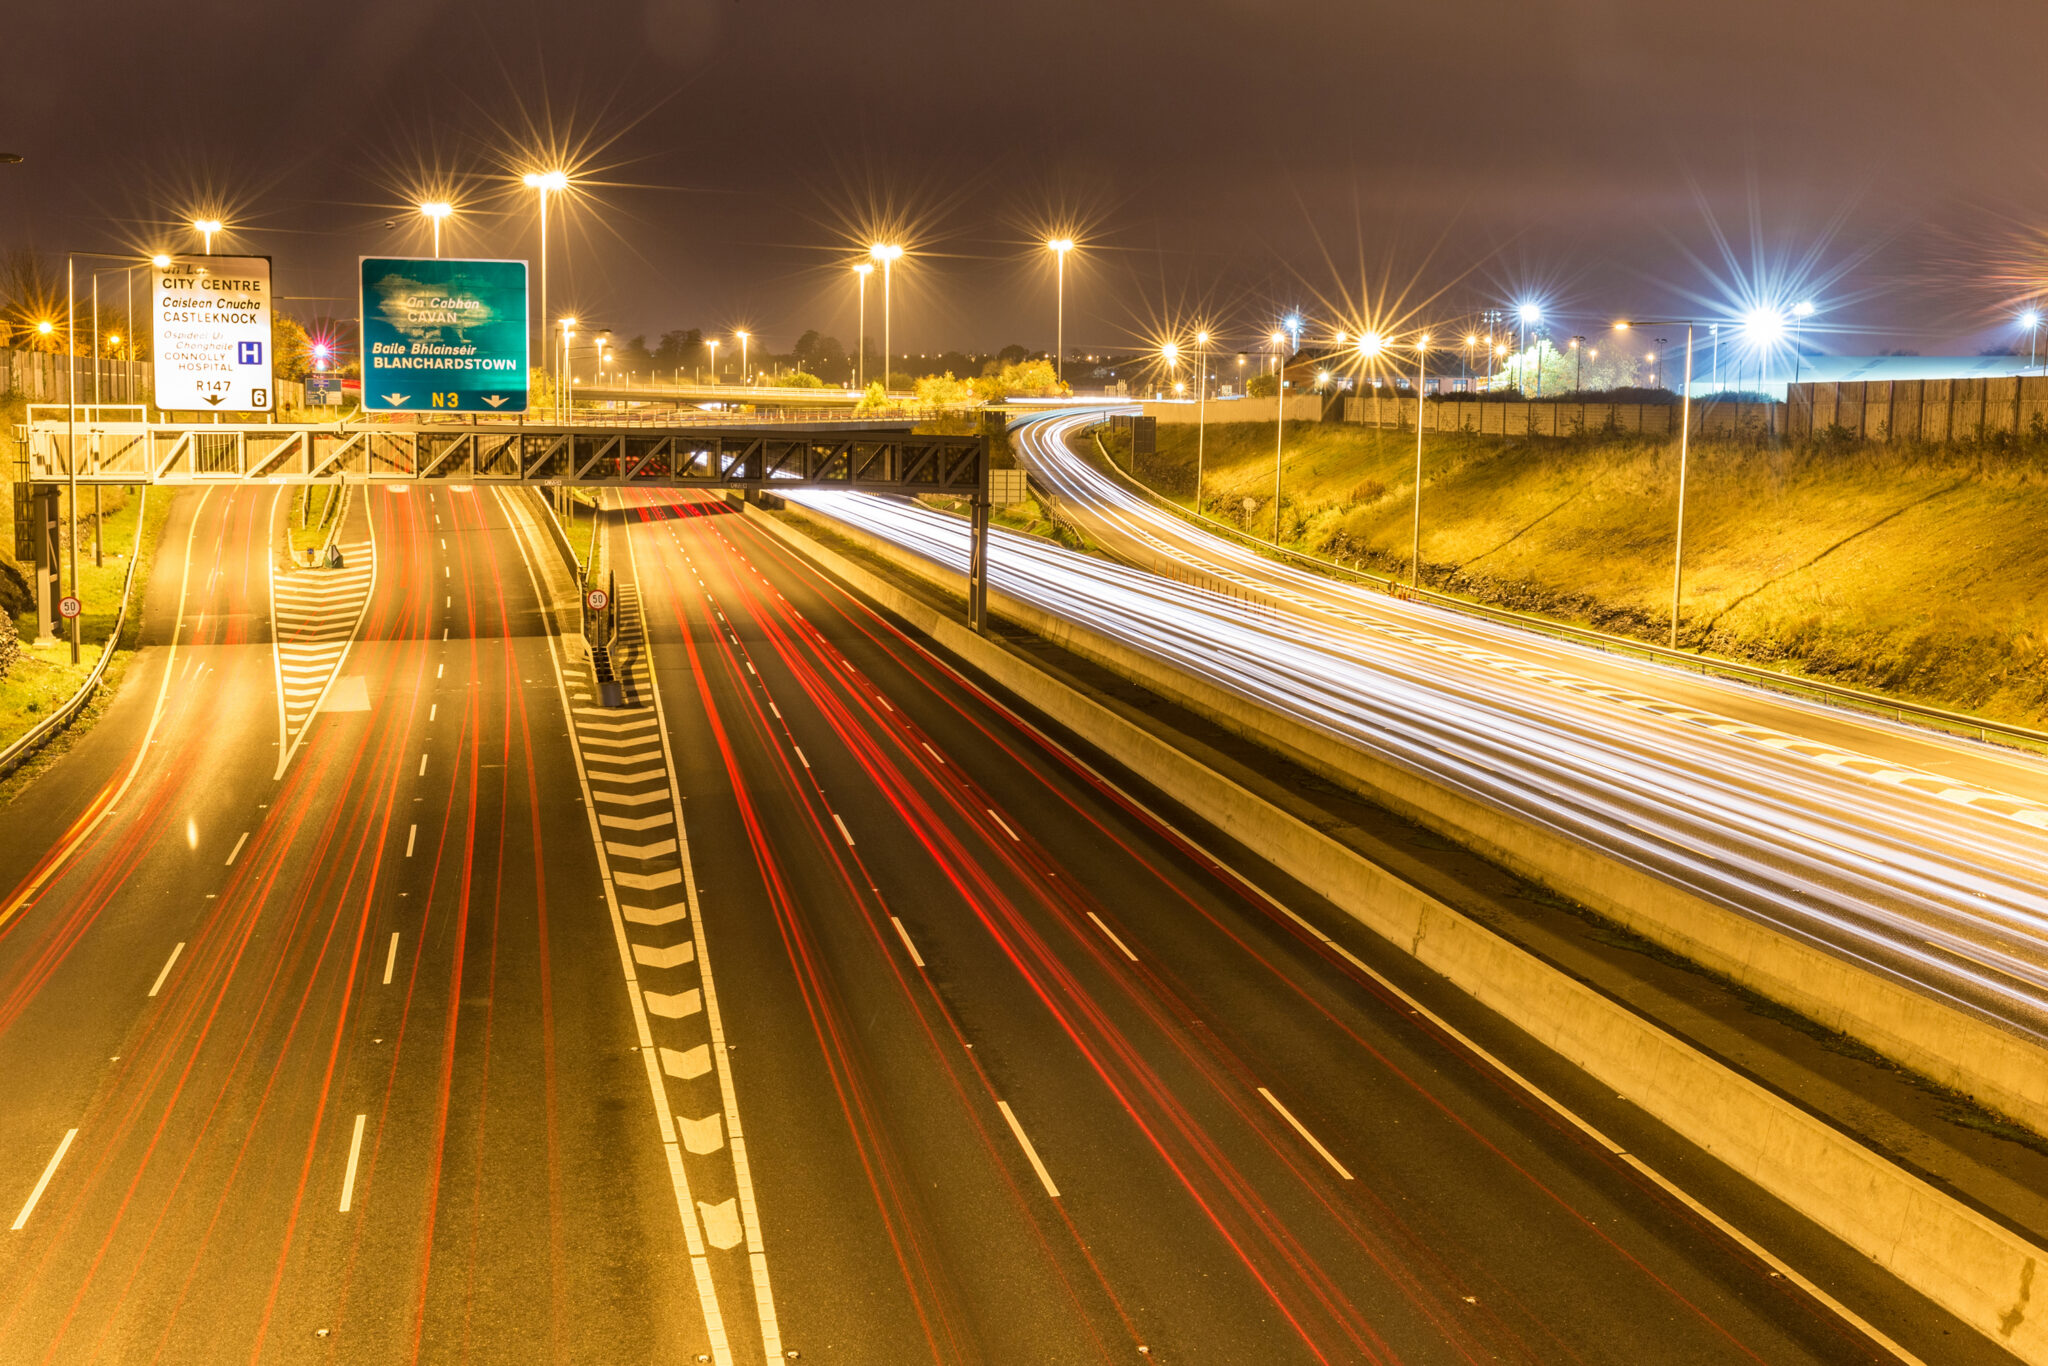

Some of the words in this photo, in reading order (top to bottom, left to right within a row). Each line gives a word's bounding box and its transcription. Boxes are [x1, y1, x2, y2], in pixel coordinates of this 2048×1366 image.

[162, 278, 195, 289] CITY
[201, 279, 261, 291] CENTRE
[216, 298, 261, 310] Cnucha
[163, 312, 257, 324] CASTLEKNOCK
[407, 311, 457, 323] CAVAN
[241, 343, 259, 363] H
[372, 342, 406, 354] Baile
[164, 352, 226, 361] CONNOLLY
[178, 363, 233, 371] HOSPITAL
[373, 357, 517, 370] BLANCHARDSTOWN
[196, 380, 231, 392] R147
[253, 390, 265, 406] 6
[592, 594, 603, 604] 50
[64, 601, 76, 611] 50
